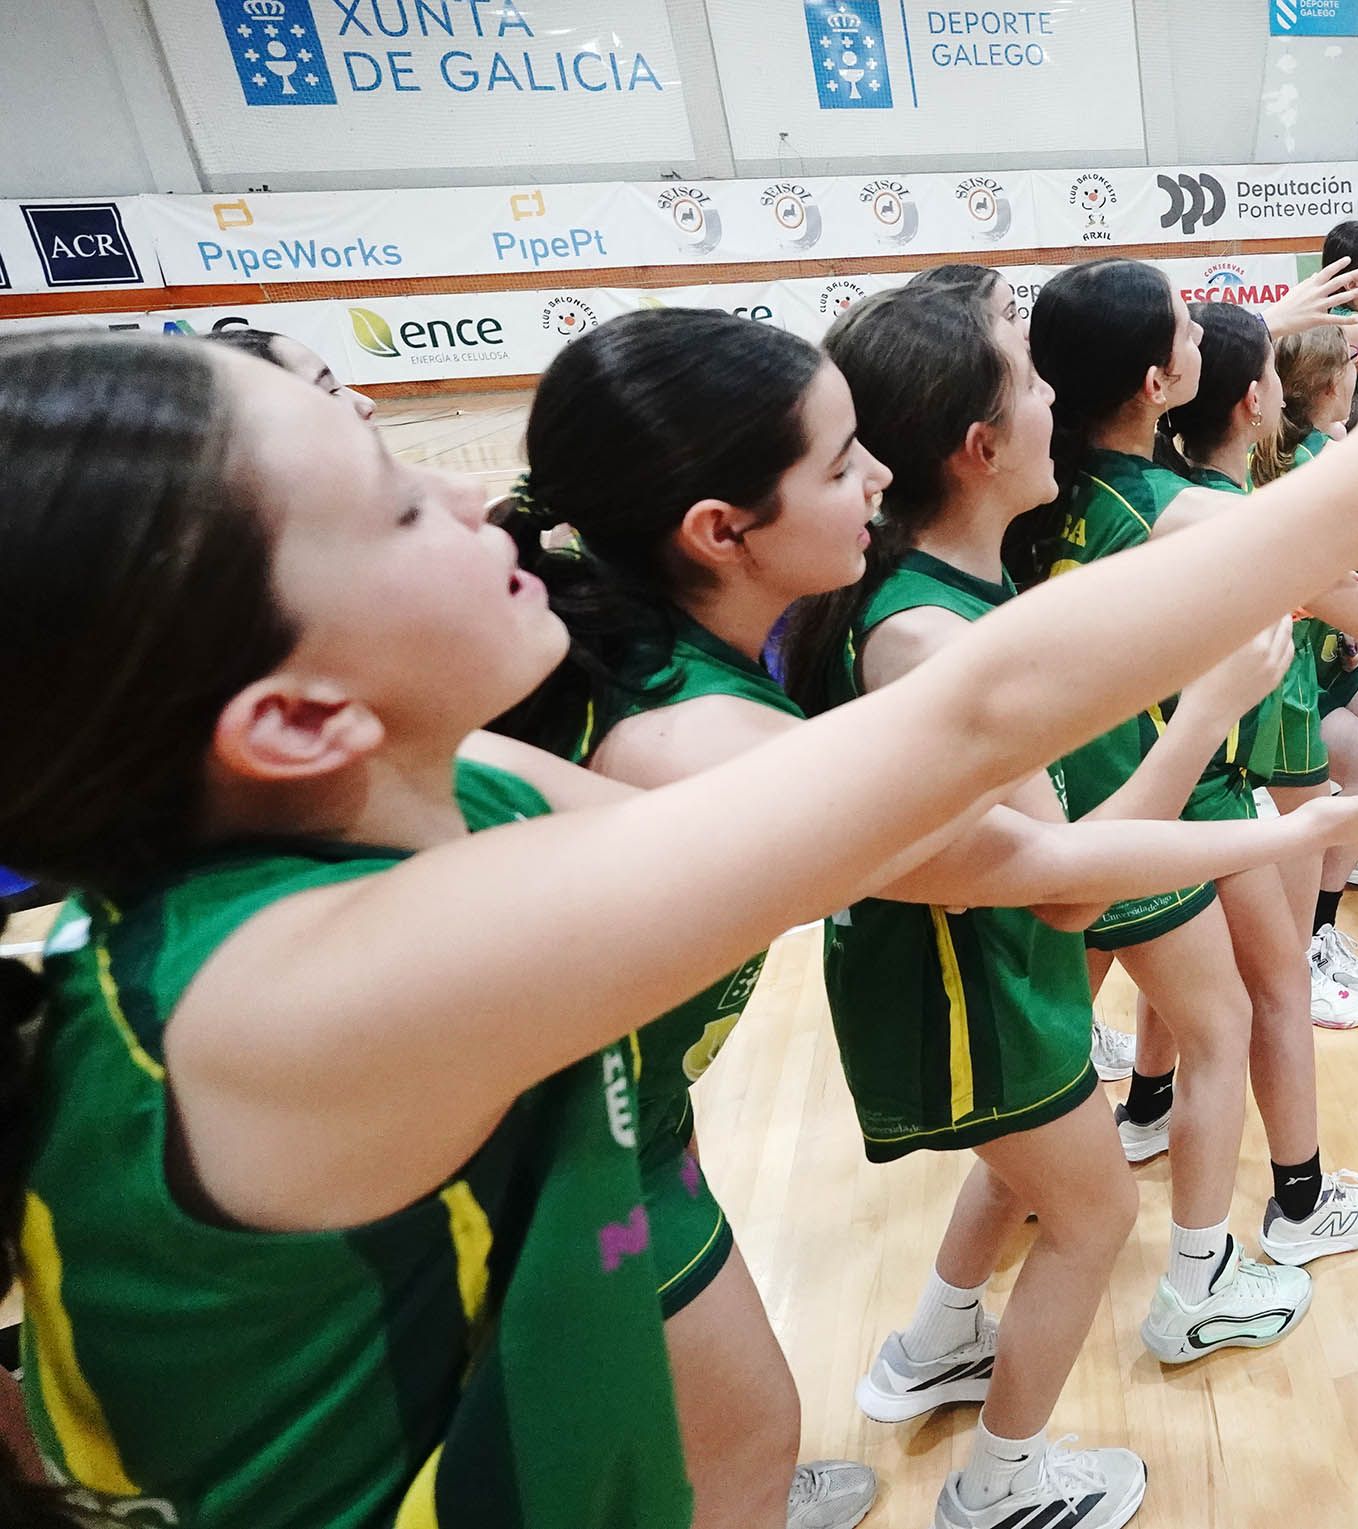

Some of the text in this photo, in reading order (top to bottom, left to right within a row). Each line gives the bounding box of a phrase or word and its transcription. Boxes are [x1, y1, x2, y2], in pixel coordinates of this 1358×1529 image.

[334, 0, 534, 37] XUNTA
[928, 12, 1053, 34] DEPORTE
[1301, 9, 1336, 17] GALEGO
[932, 44, 1044, 66] GALEGO
[343, 51, 663, 91] DE GALICIA
[657, 187, 712, 208] SEISOL
[760, 183, 812, 206] SEISOL
[859, 180, 910, 201] SEISOL
[956, 177, 1004, 199] SEISOL
[1069, 173, 1117, 204] CLUB BALONCESTO
[1237, 176, 1352, 201] Deputación
[1238, 199, 1353, 219] Pontevedra
[51, 233, 124, 259] ACR
[1082, 231, 1111, 241] ARXIL
[198, 238, 402, 278] PipeWorks
[492, 229, 607, 266] PipePt
[1204, 262, 1245, 277] CONSERVAS
[827, 281, 867, 299] BALONCE
[542, 296, 599, 329] CLUB BALONCESTO
[400, 316, 504, 349] ence
[411, 352, 509, 364] ENERGÍA & CELULOSA
